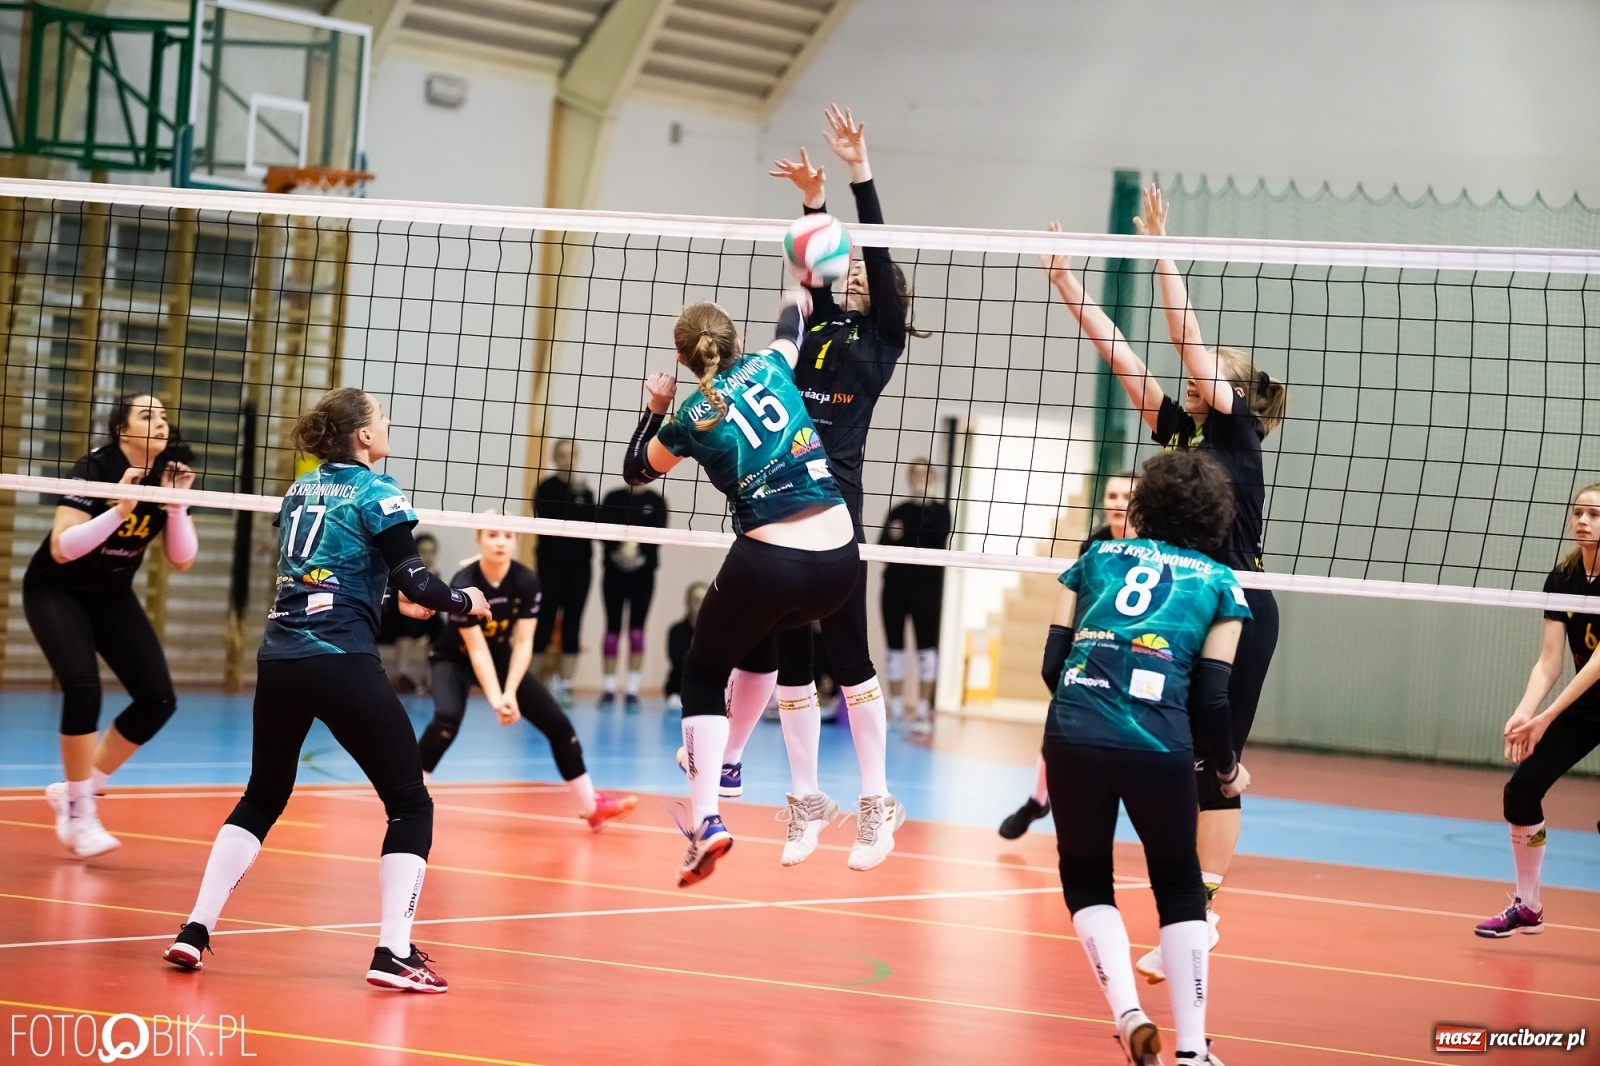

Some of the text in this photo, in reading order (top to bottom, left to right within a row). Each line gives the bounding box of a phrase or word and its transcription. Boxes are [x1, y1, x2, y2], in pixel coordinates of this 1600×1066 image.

[815, 340, 832, 369] 1
[688, 401, 712, 422] UKS
[832, 392, 854, 404] JSW
[725, 383, 790, 449] 15
[296, 483, 360, 499] KRZANOWICE
[117, 513, 152, 539] 34
[287, 504, 327, 558] 17
[1097, 542, 1214, 574] UKS KRZANOWICE
[1115, 566, 1161, 616] 8
[1585, 622, 1598, 650] 6
